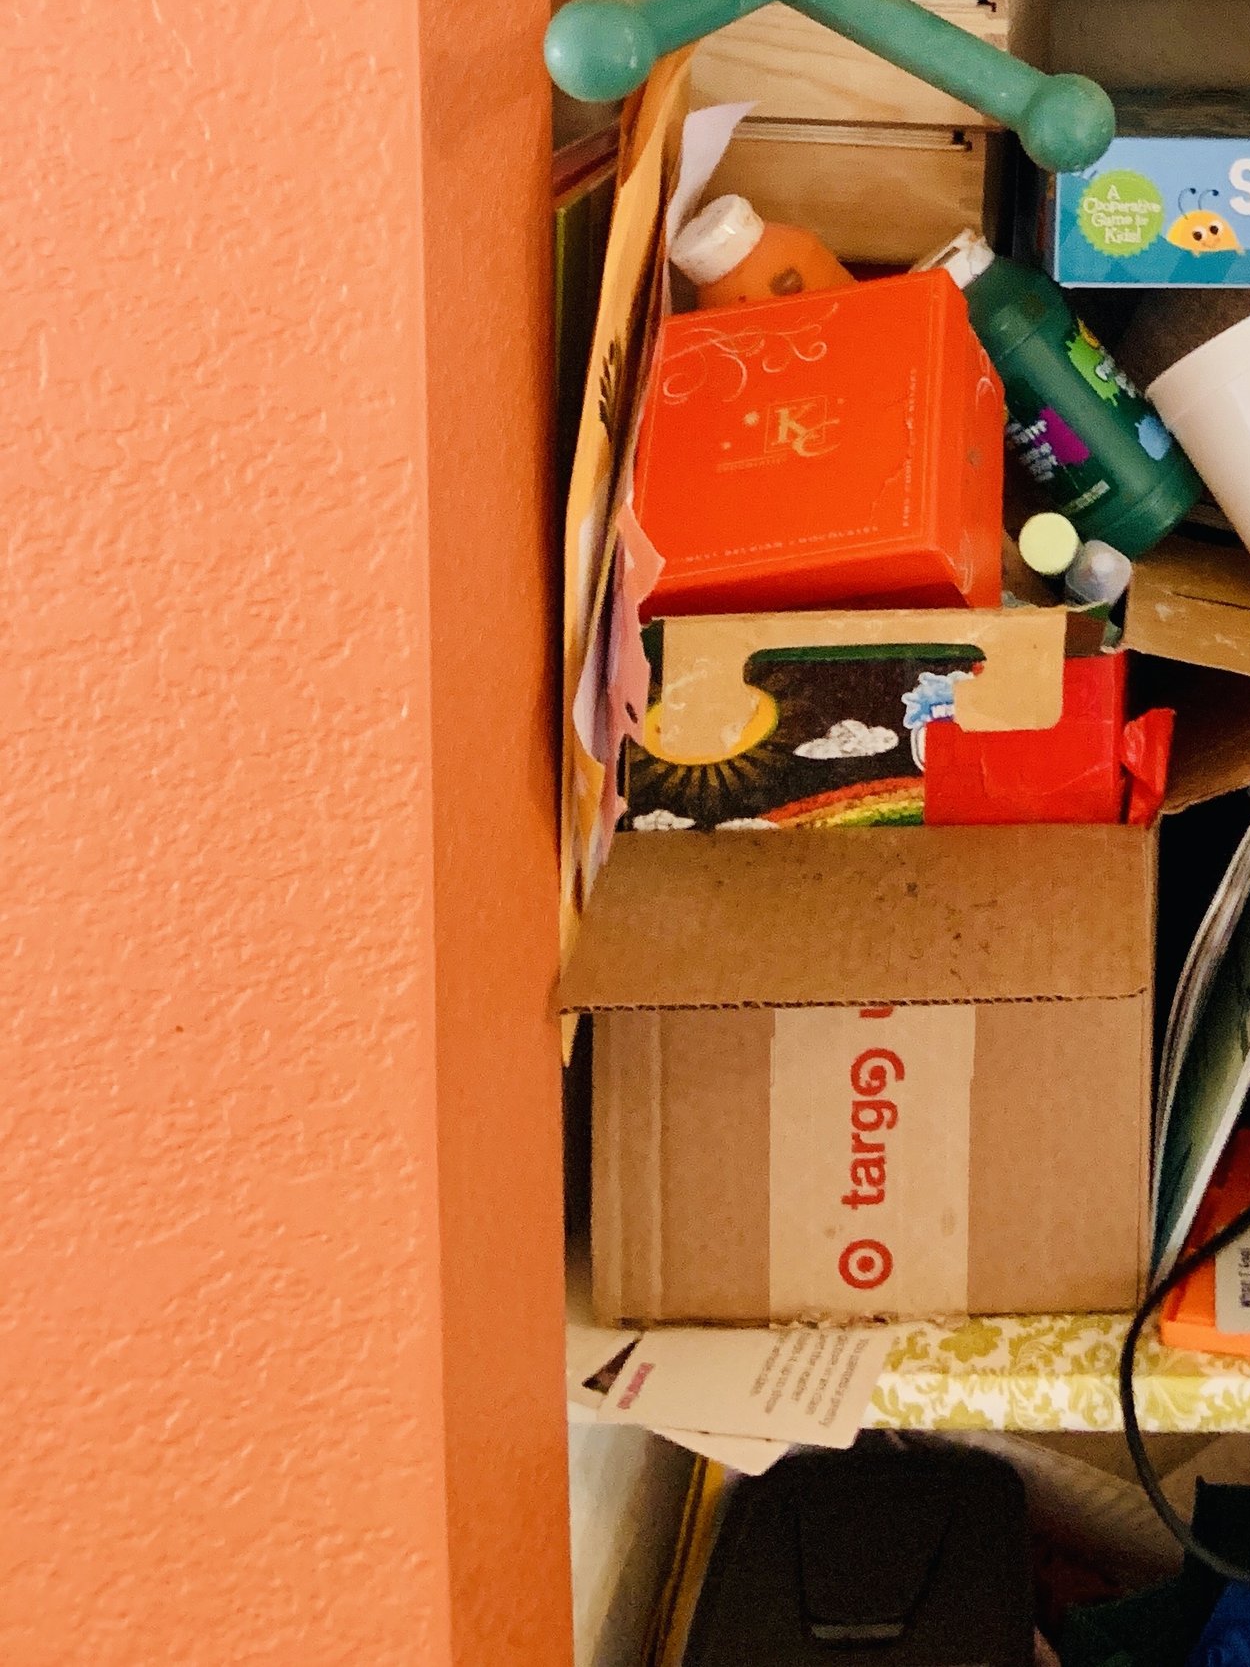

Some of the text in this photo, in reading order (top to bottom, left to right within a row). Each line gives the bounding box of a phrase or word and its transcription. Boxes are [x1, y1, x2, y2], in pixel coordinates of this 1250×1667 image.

[1083, 197, 1161, 215] Cooperative
[1091, 212, 1133, 227] Game
[1103, 226, 1142, 245] Kids!
